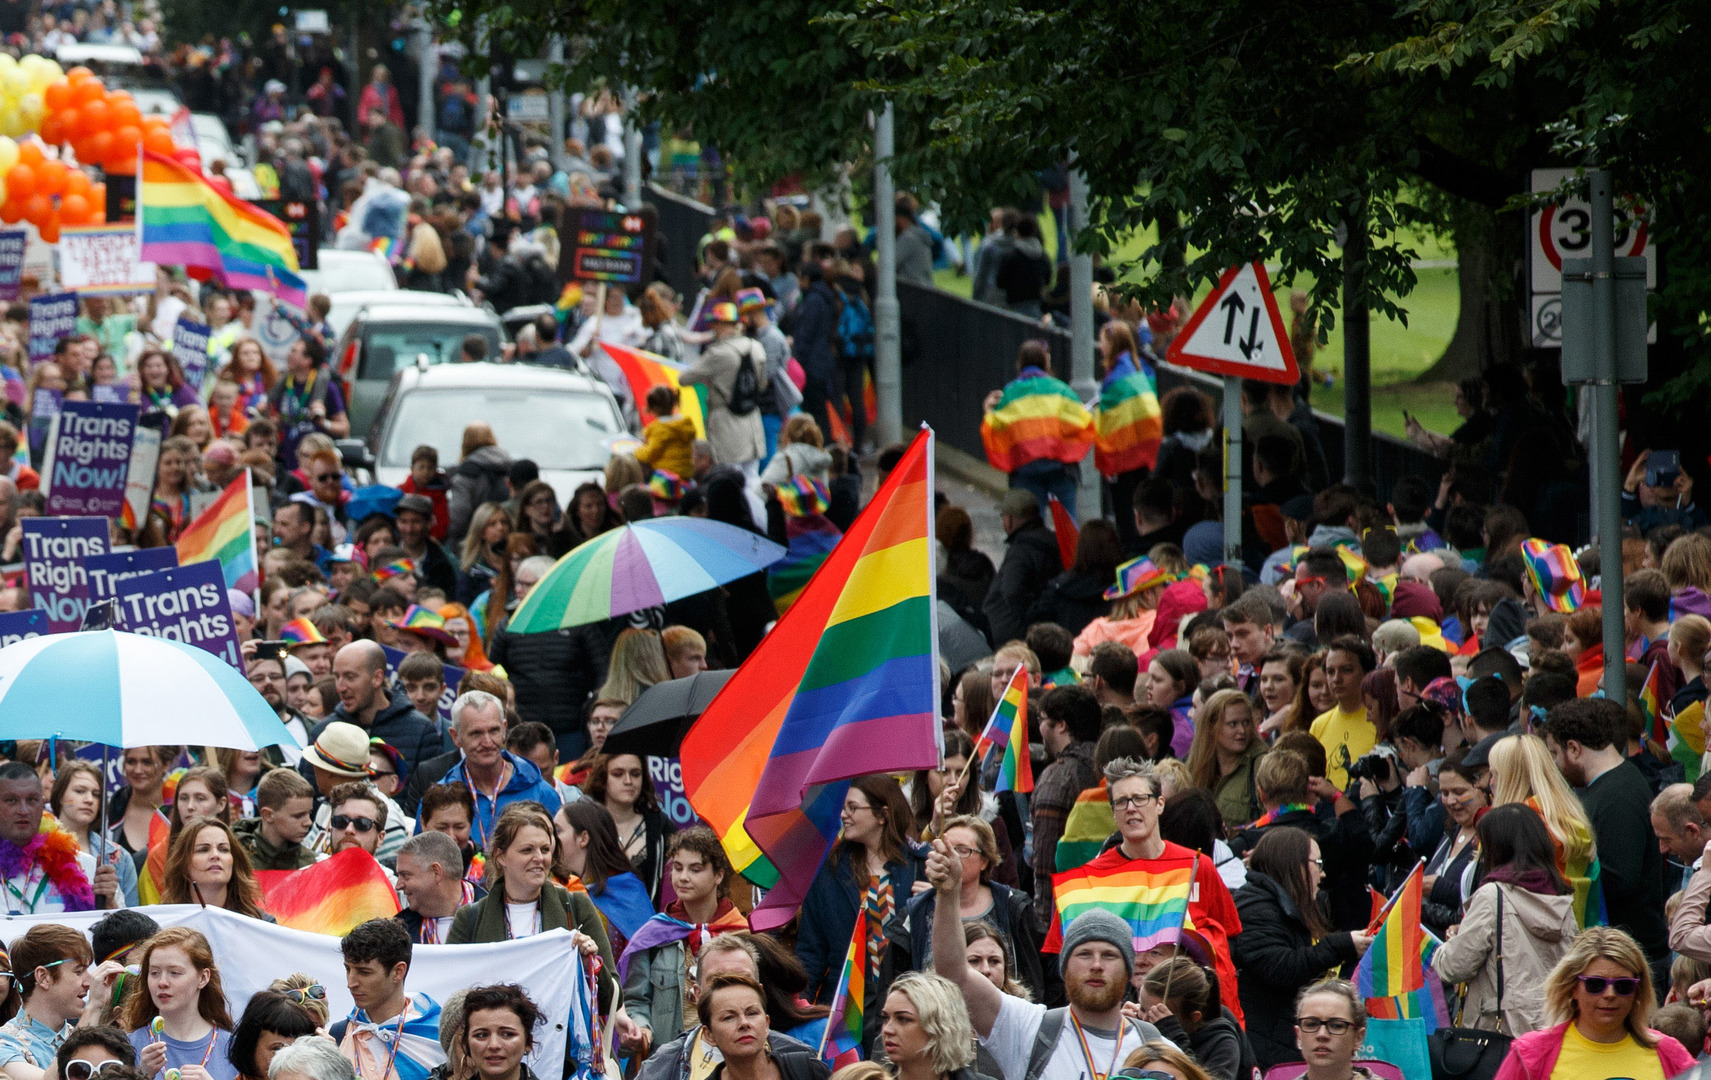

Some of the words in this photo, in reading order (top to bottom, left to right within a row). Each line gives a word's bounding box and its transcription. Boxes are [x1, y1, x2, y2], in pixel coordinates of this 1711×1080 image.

[63, 411, 130, 437] Trans
[58, 435, 129, 465] Rights
[53, 460, 127, 490] Now!
[25, 532, 105, 559] Trans
[29, 560, 87, 594] Righ
[33, 592, 91, 623] No
[124, 581, 221, 625] Trans
[647, 755, 685, 793] Rig
